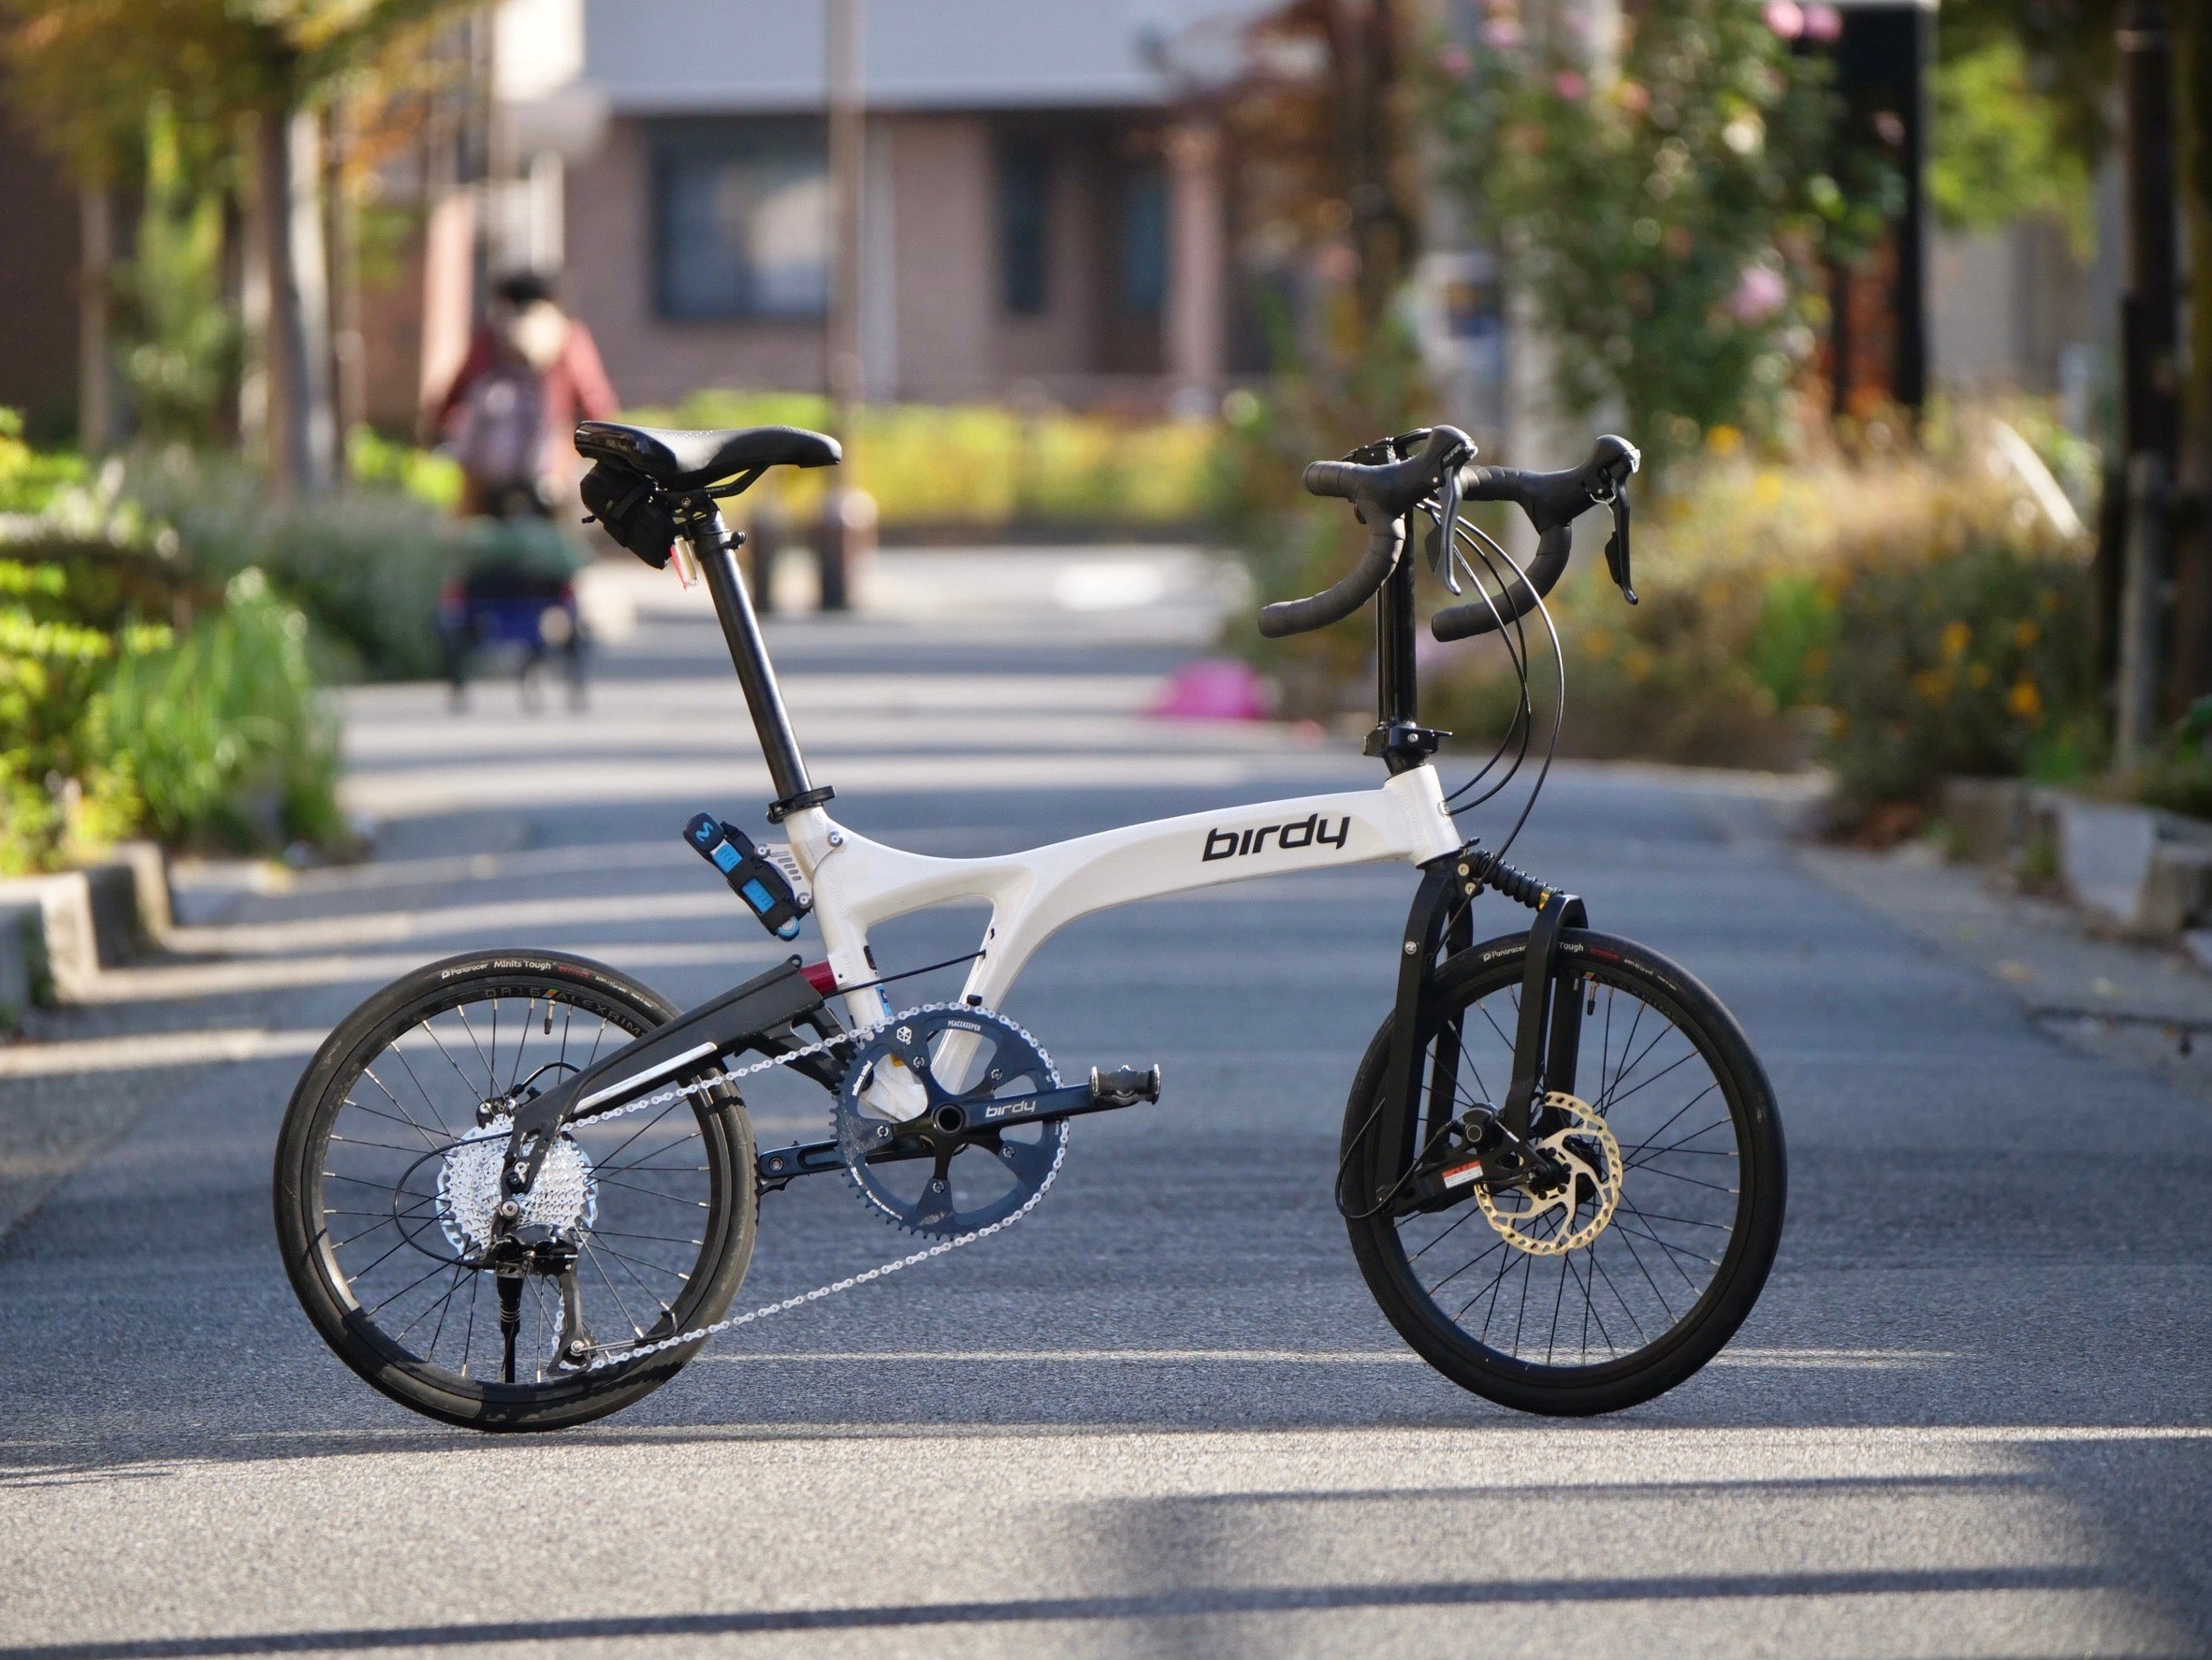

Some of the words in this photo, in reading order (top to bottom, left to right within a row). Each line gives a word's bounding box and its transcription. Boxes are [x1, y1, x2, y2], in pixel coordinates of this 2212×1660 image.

[1202, 813, 1351, 862] birdy
[1492, 945, 1527, 958] Panaracer
[1558, 941, 1584, 953] Tough
[451, 963, 489, 976] Panaracer
[493, 959, 522, 968] Minits
[524, 960, 552, 971] Tough
[557, 992, 645, 1037] ALEXRIM
[947, 1019, 982, 1031] PEACEKEEPER
[984, 1099, 1037, 1118] birdy
